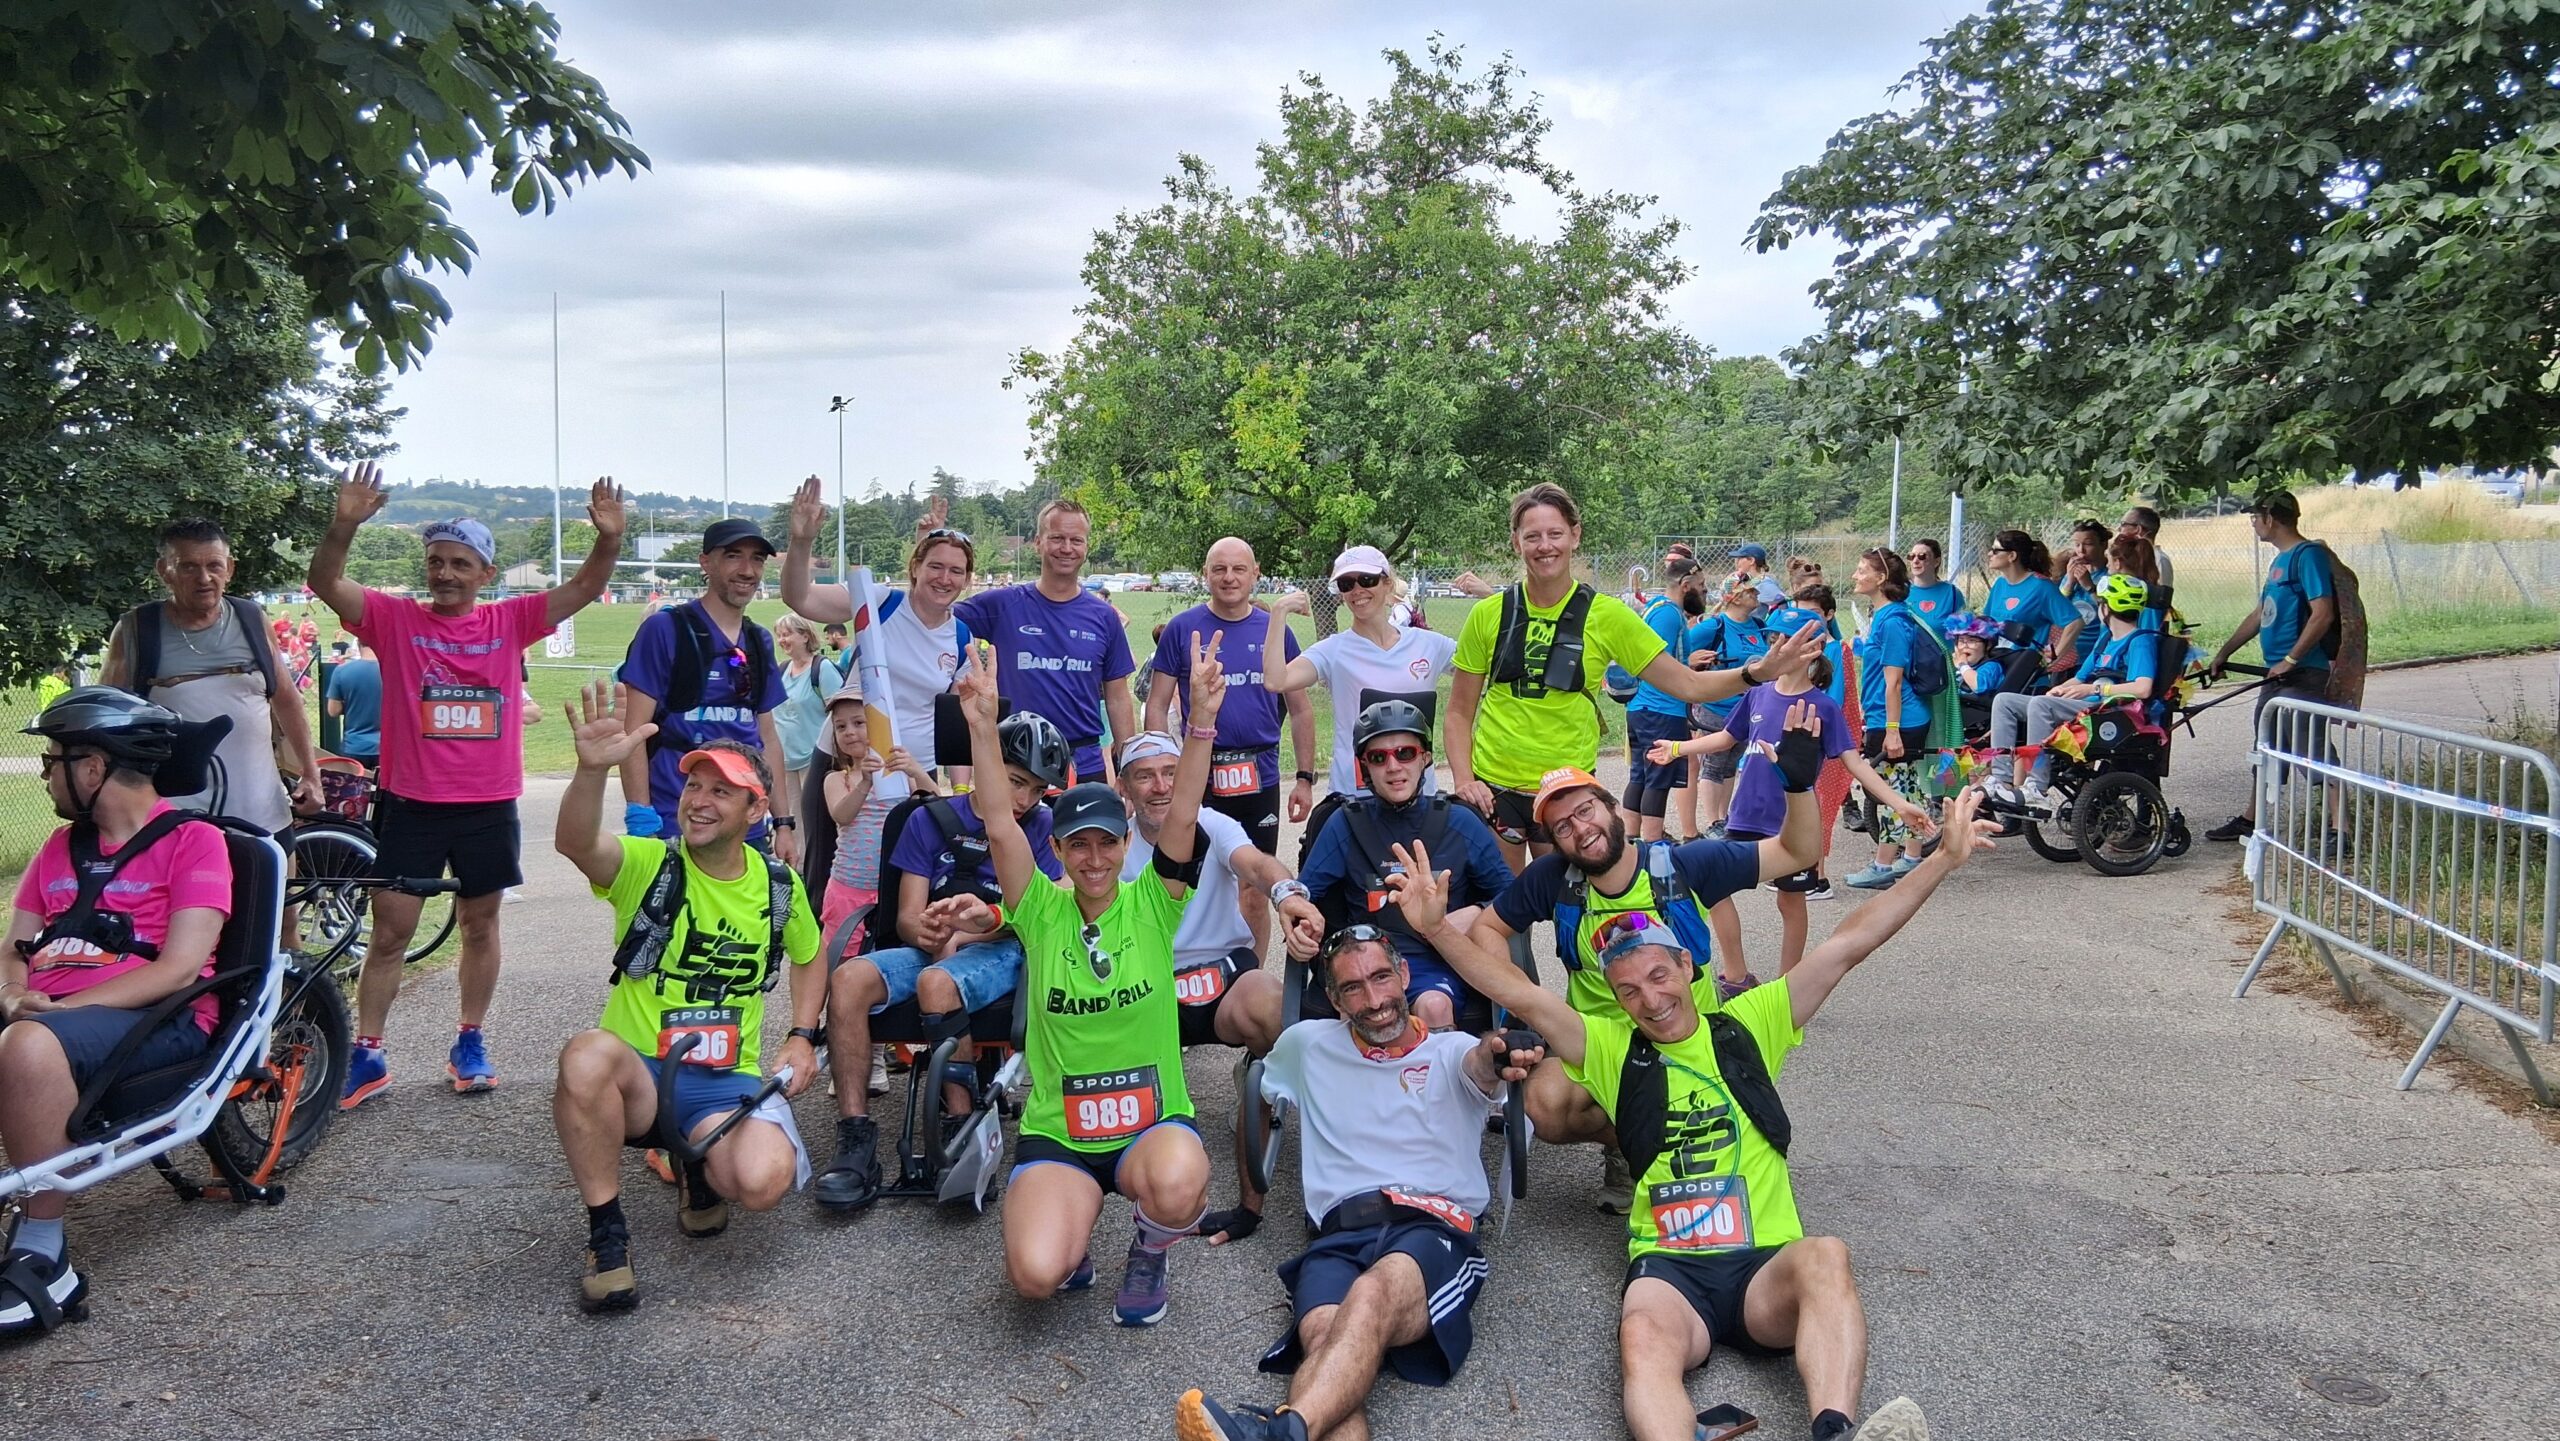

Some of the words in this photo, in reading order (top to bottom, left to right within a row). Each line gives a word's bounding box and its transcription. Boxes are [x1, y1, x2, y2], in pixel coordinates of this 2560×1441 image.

[424, 524, 467, 541] BROOKLYN
[1017, 651, 1092, 672] BAND'RILL
[431, 689, 485, 697] SPODE
[434, 705, 482, 729] 994
[1046, 978, 1154, 1016] BAND'RILL
[669, 1009, 731, 1022] SPODE
[1073, 1072, 1141, 1090] SPODE
[1079, 1095, 1140, 1131] 989
[1659, 1181, 1726, 1198] SPODE
[1660, 1202, 1734, 1242] 1000
